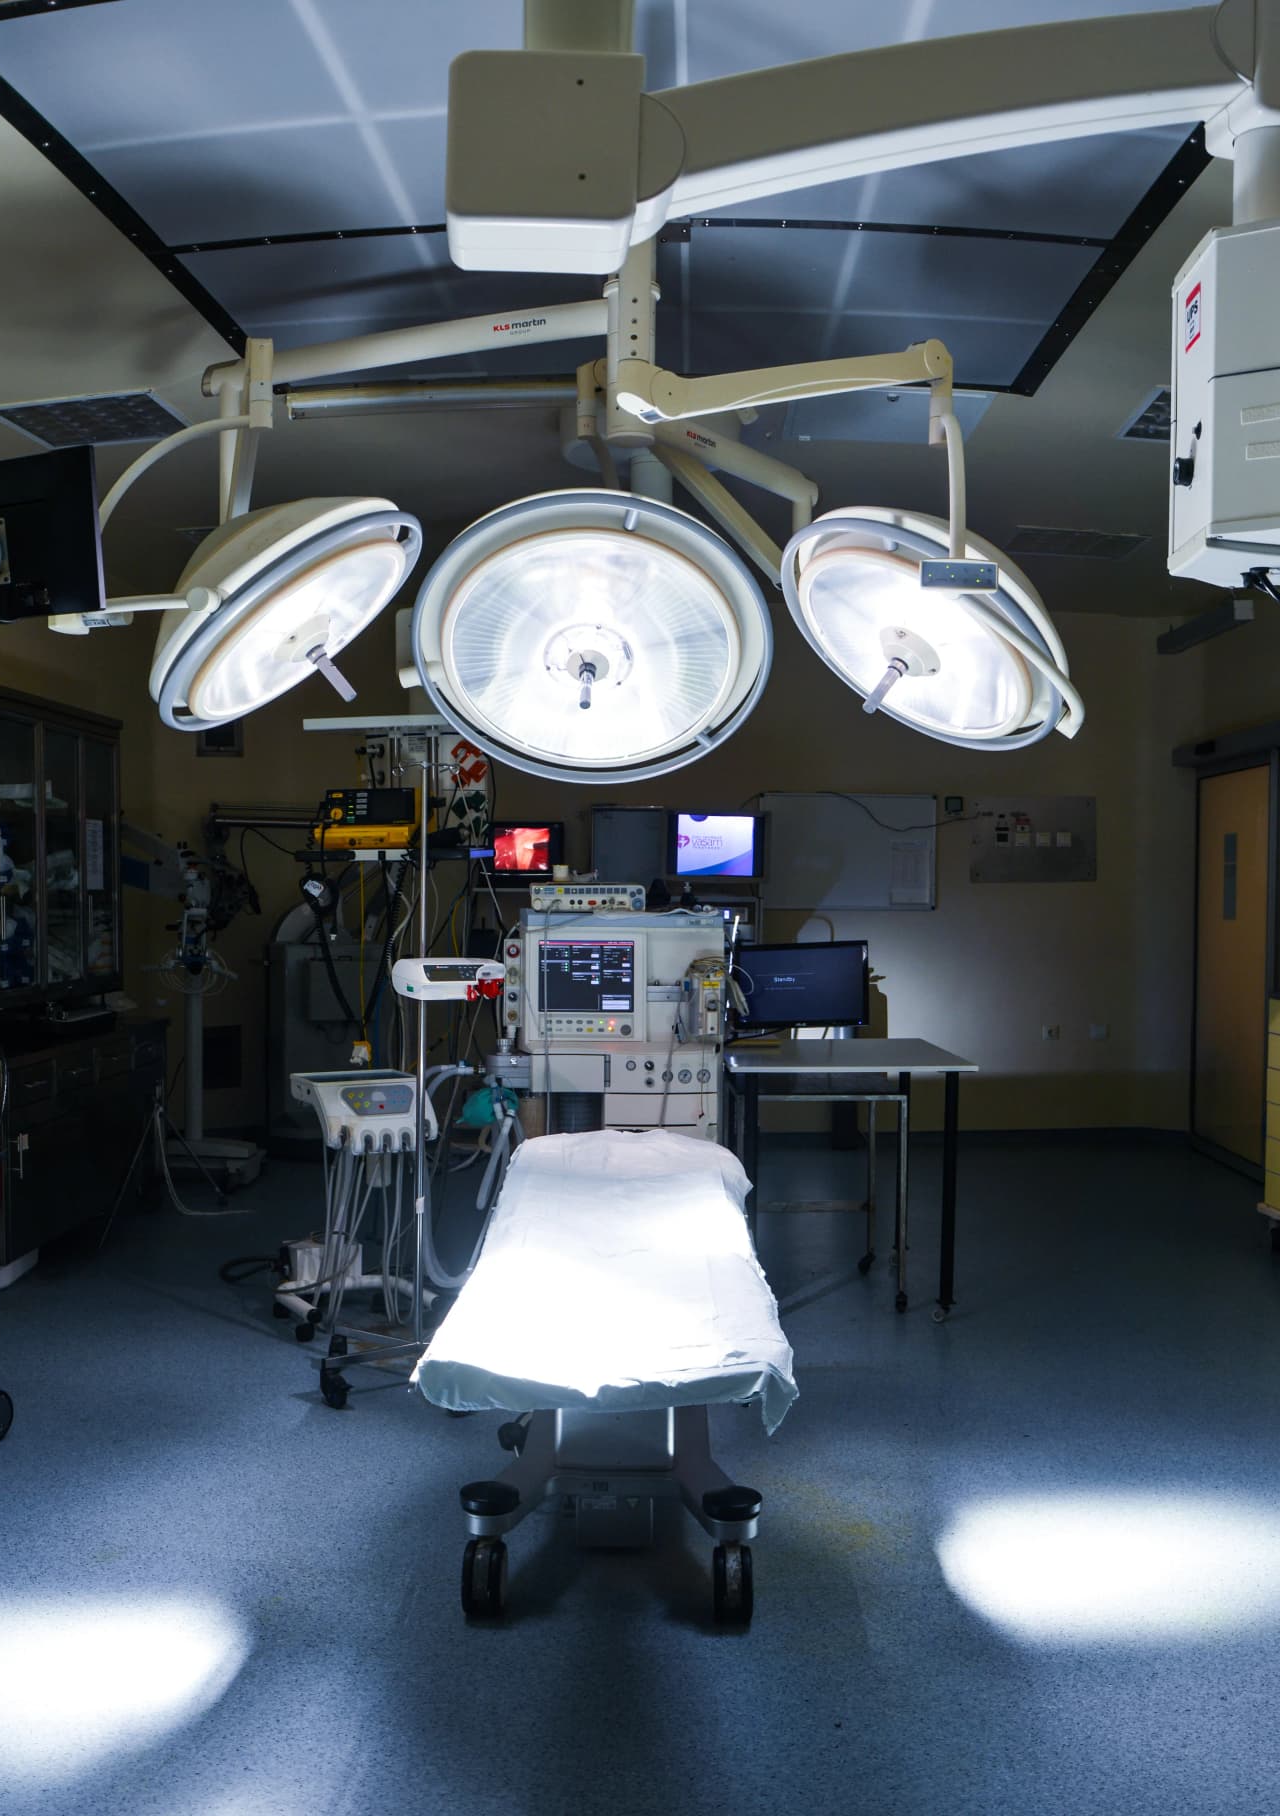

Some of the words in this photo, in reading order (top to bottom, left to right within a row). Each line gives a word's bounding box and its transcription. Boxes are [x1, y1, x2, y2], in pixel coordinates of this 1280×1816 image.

[1186, 299, 1199, 323] UPS
[493, 323, 510, 332] KLS
[511, 318, 547, 330] martin
